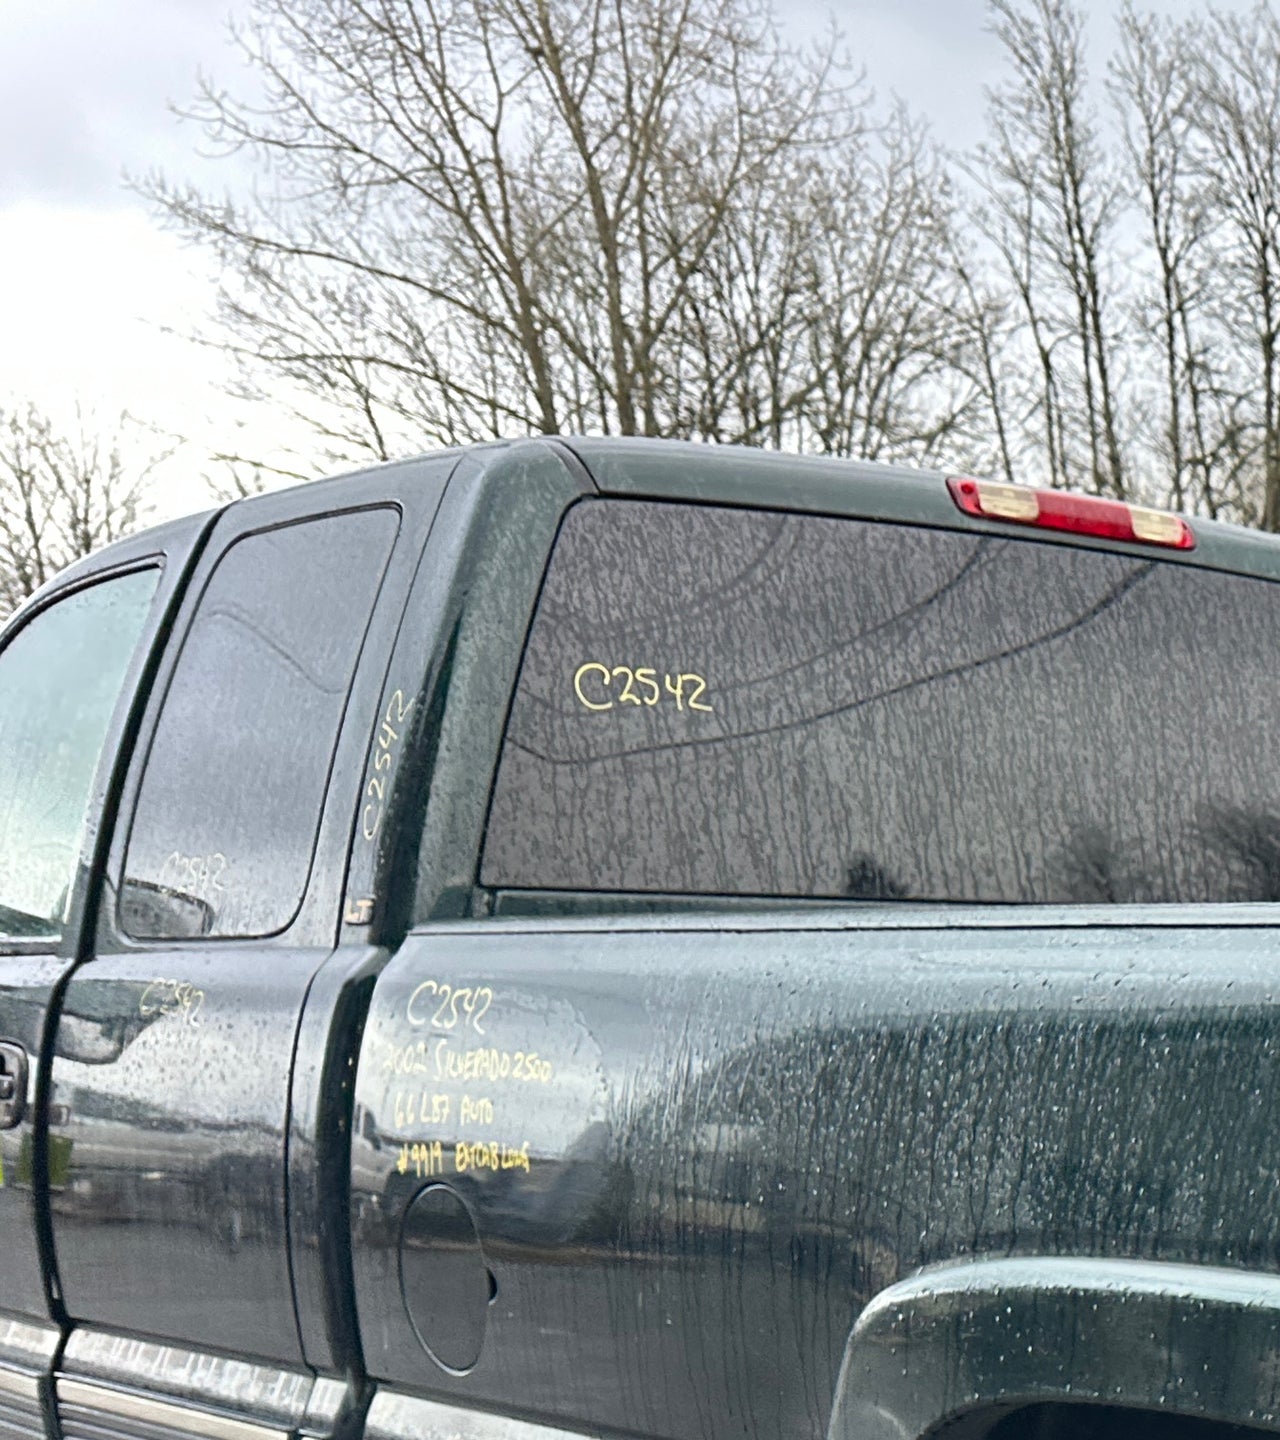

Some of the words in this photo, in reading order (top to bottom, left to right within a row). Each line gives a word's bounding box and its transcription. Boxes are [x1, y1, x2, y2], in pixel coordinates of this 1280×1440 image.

[573, 662, 713, 711] C2542
[363, 689, 416, 841] C2542
[406, 980, 493, 1035] C2542
[512, 1051, 552, 1082] 2500
[460, 1094, 493, 1126] AUTO
